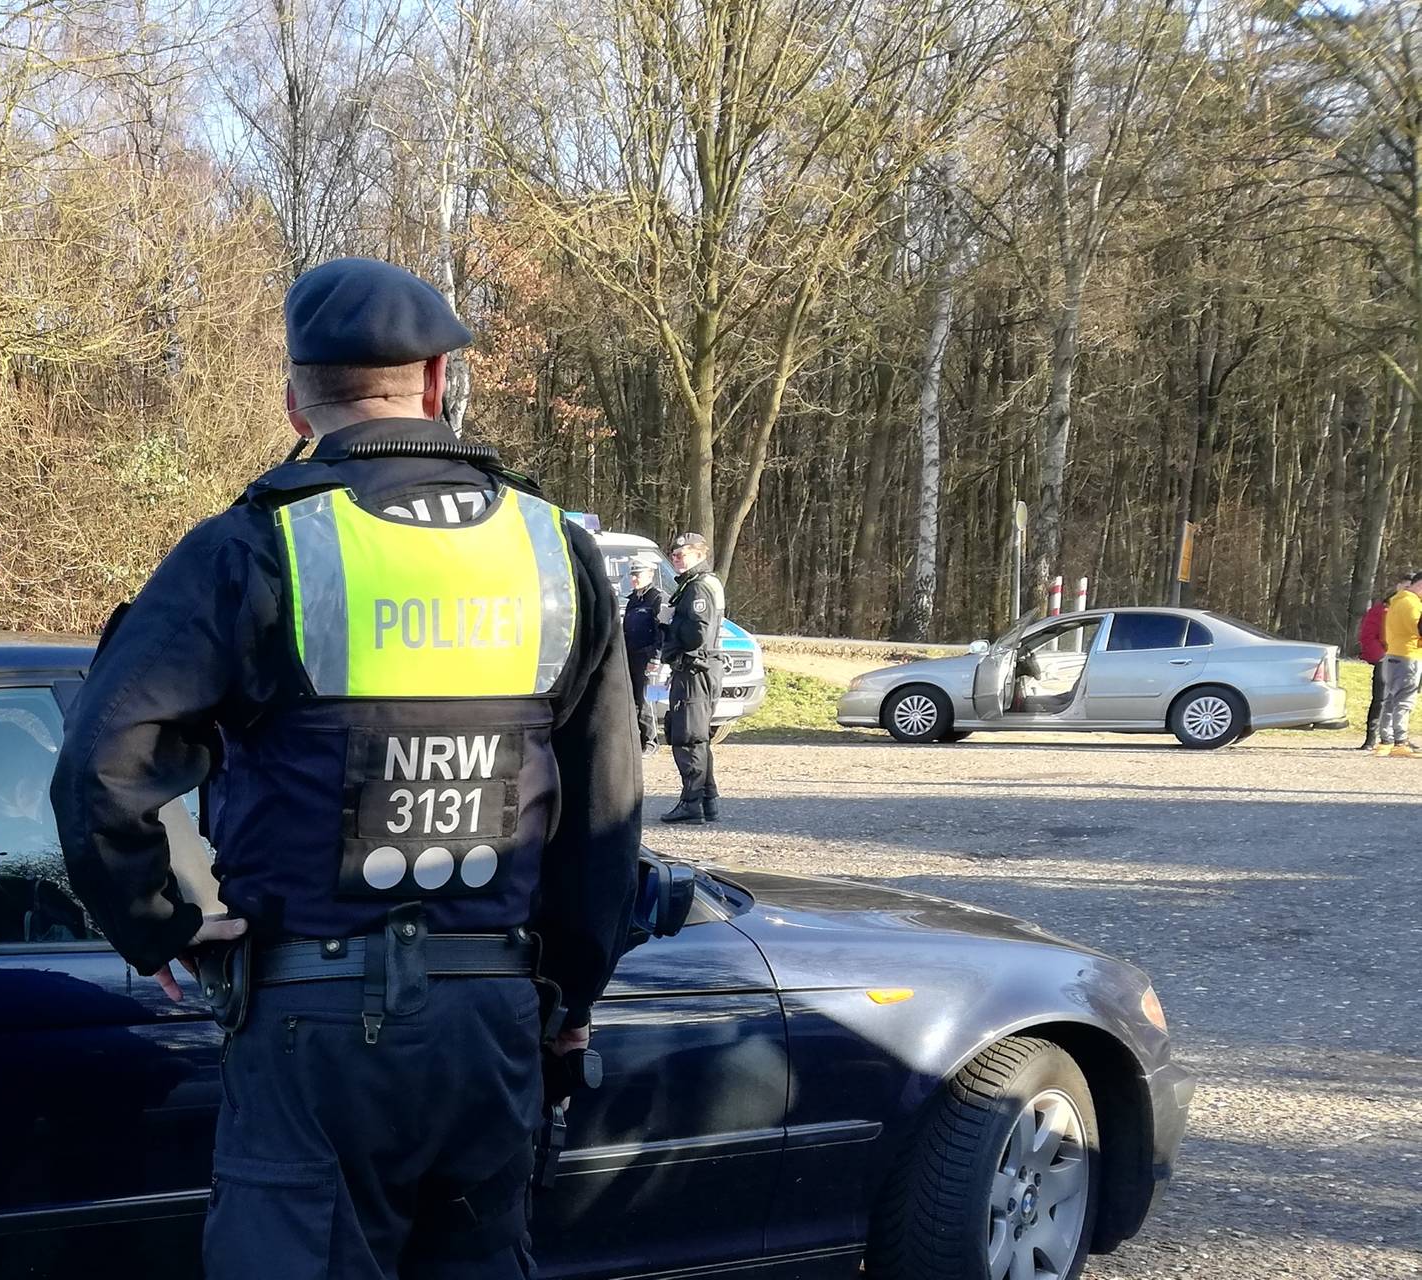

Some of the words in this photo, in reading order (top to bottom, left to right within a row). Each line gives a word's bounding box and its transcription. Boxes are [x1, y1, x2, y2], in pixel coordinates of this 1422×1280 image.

[375, 598, 522, 649] POLIZEI
[384, 735, 501, 781] NRW
[386, 788, 482, 834] 3131
